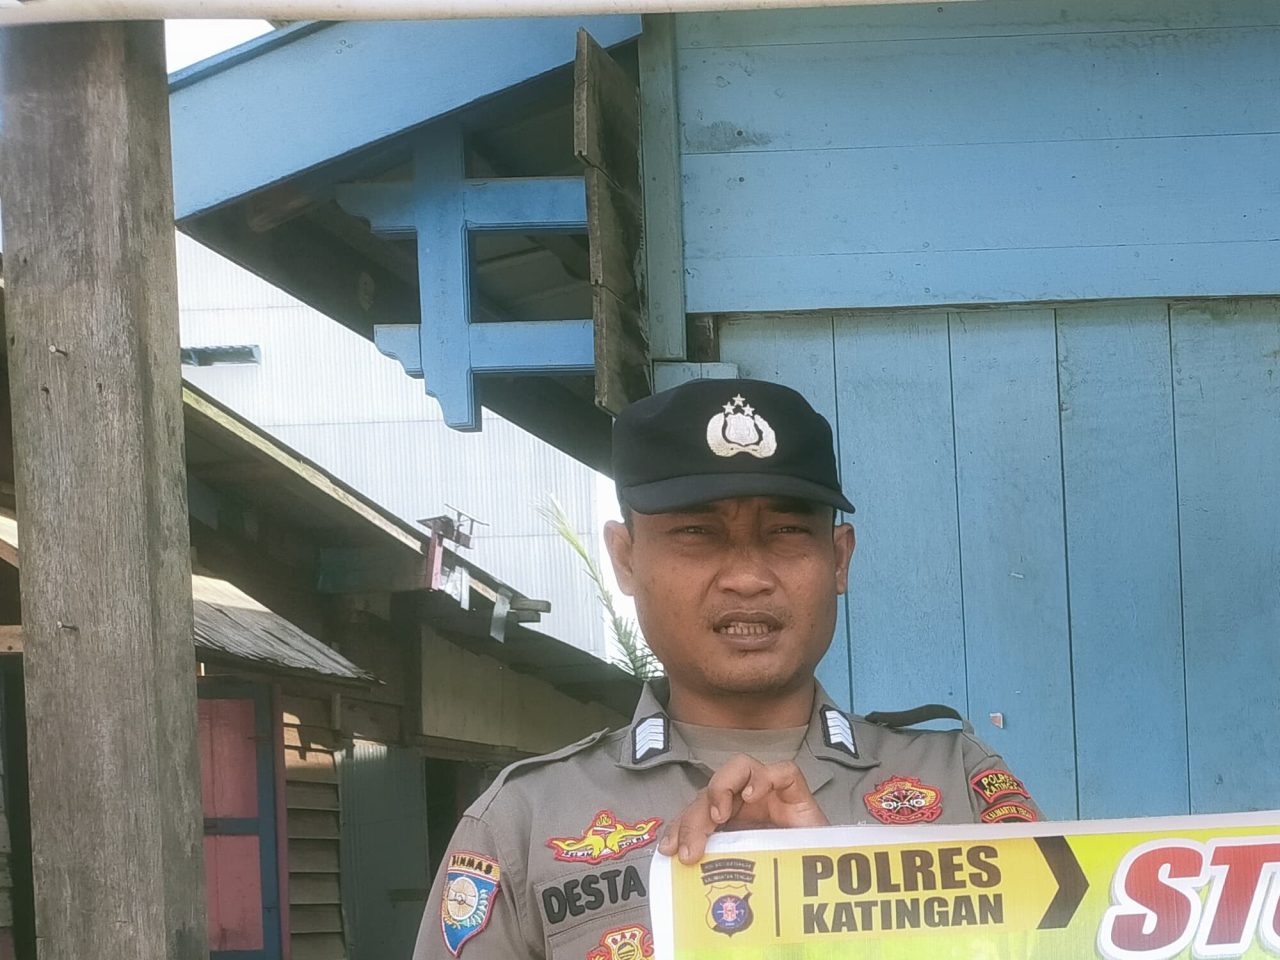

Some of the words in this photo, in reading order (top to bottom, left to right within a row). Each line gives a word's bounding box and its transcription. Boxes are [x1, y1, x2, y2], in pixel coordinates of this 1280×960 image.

[541, 865, 647, 925] DESTA
[801, 844, 1001, 898] POLRES
[801, 893, 1004, 934] KATINGAN
